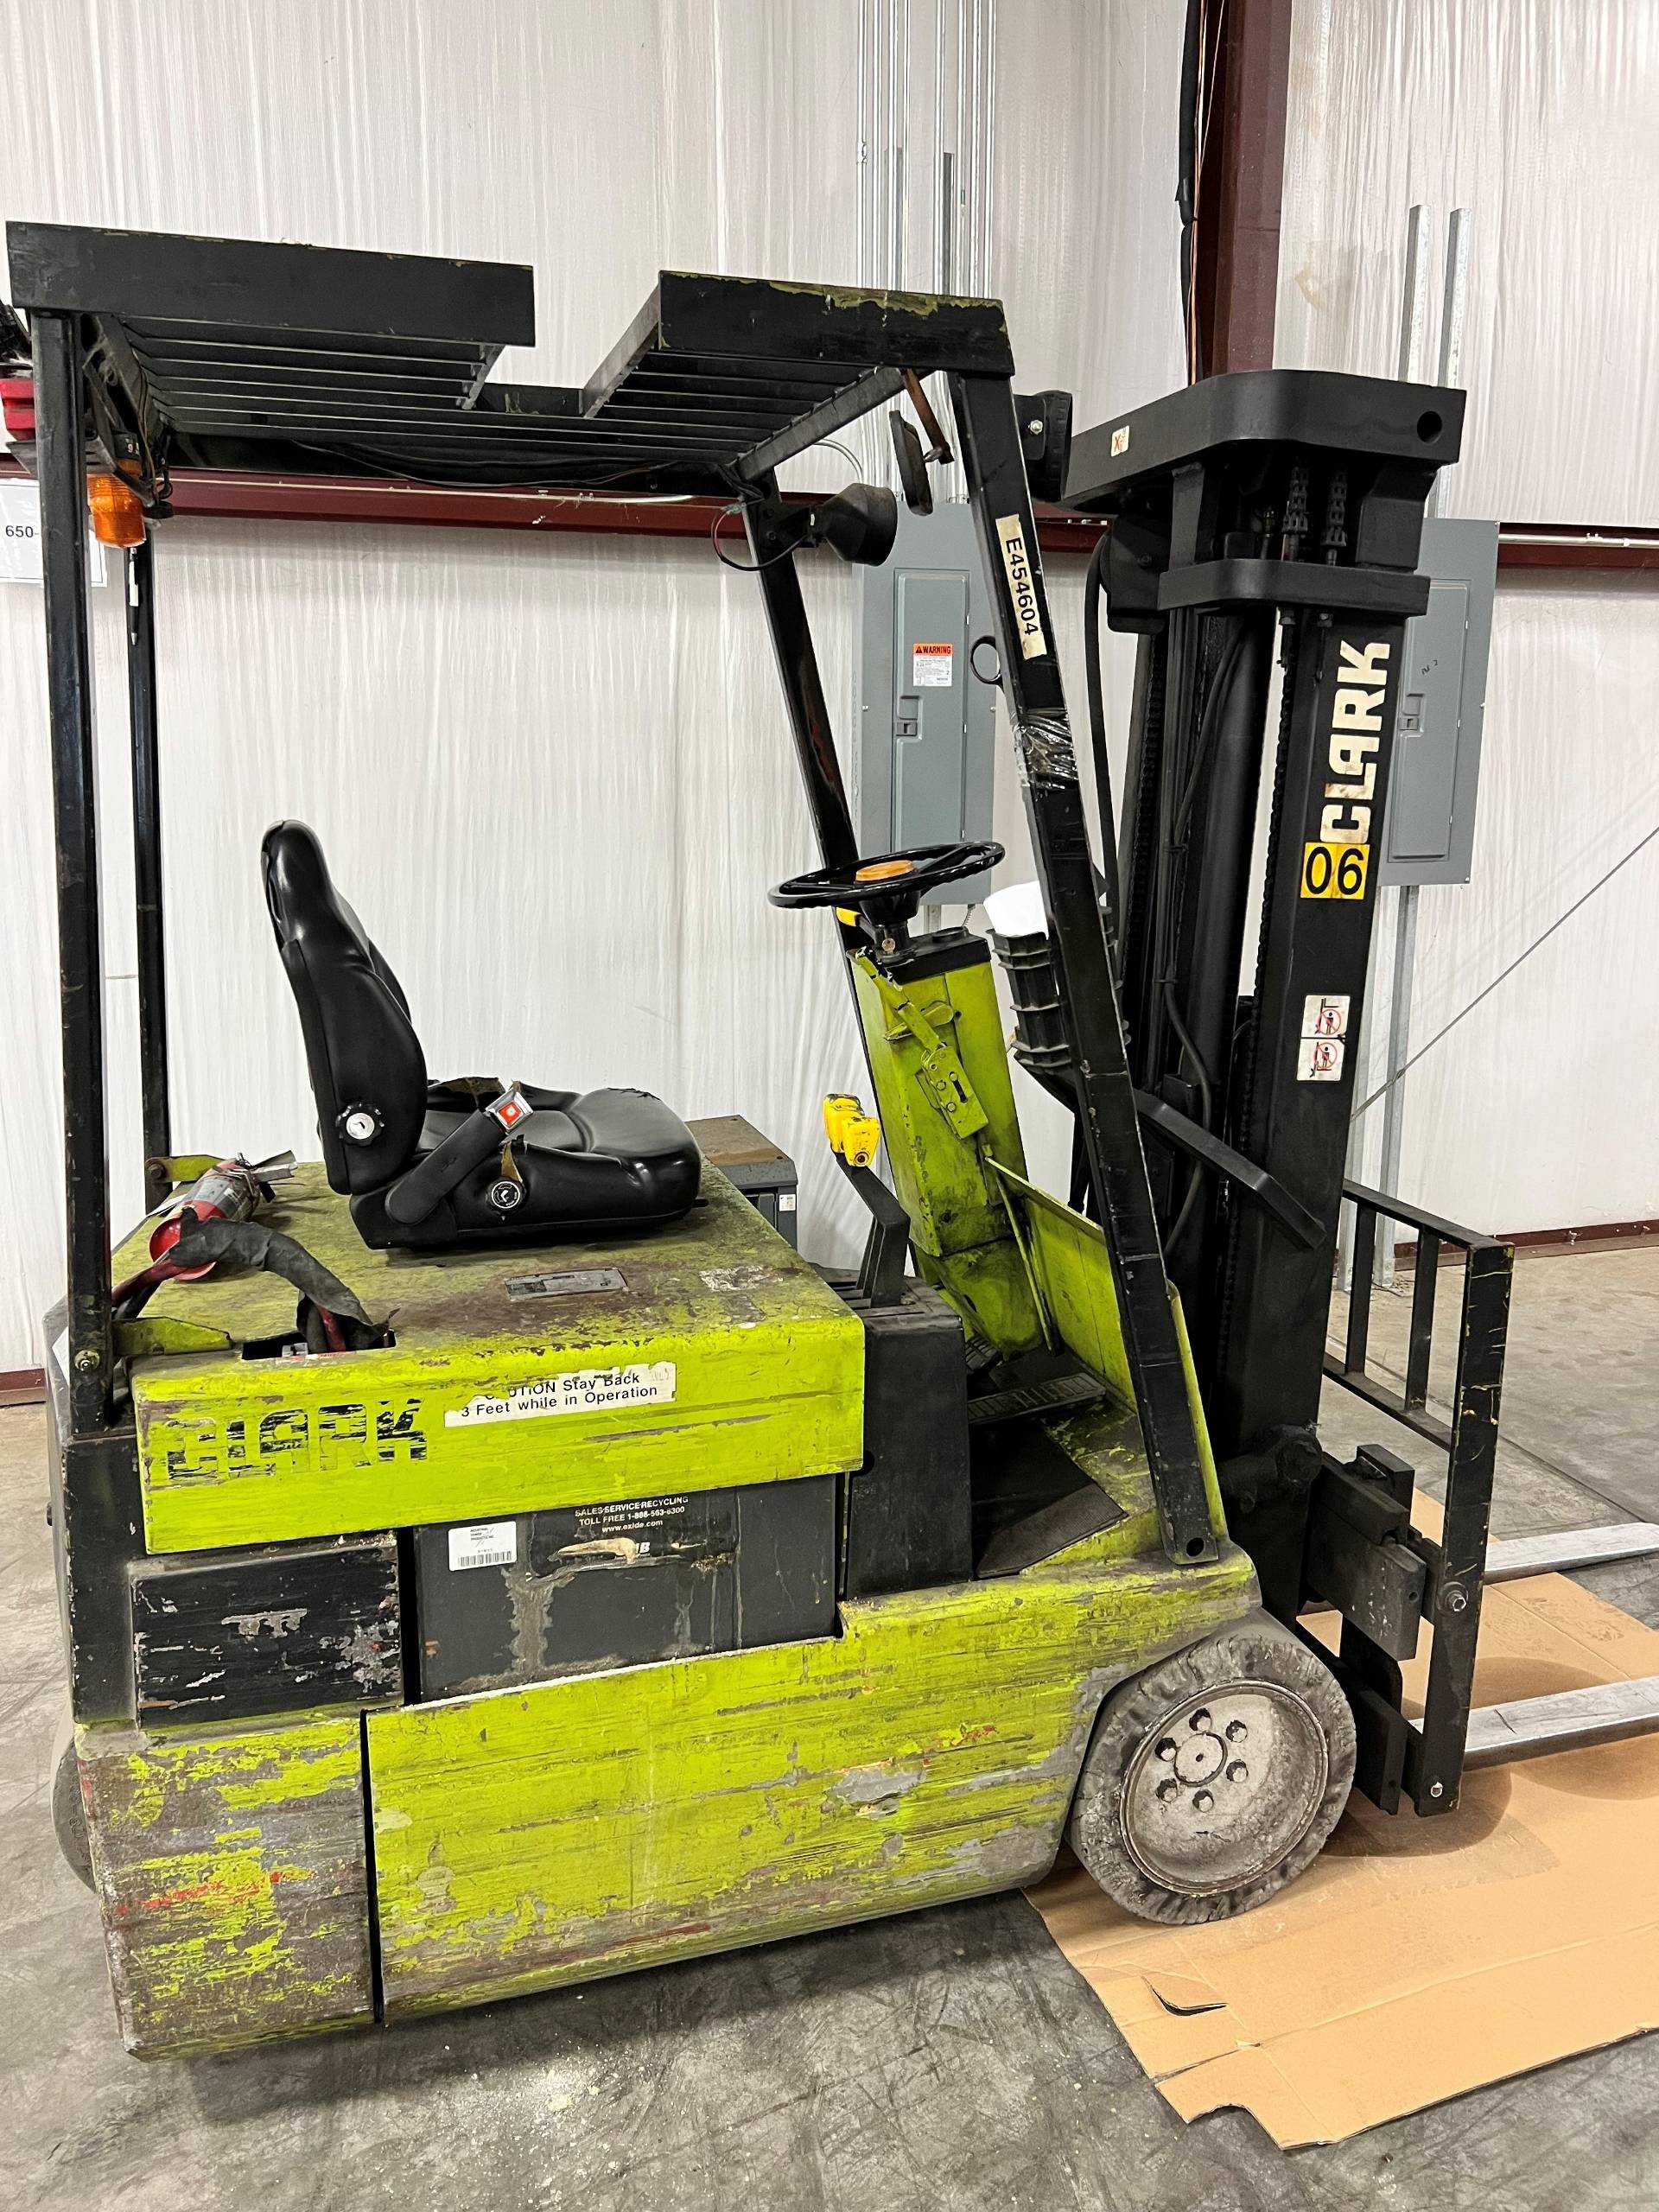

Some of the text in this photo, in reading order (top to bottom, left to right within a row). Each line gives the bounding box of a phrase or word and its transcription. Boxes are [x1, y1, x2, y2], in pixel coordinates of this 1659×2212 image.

[1006, 537, 1039, 636] E454604
[922, 645, 951, 654] WARNING
[1320, 640, 1391, 843] CLARK
[1305, 846, 1364, 896] 06
[486, 1381, 556, 1400] UTION
[563, 1379, 596, 1391] Stay
[604, 1372, 640, 1387] Back
[461, 1386, 658, 1417] 3 Feet while in Operation
[579, 1517, 601, 1527] TOLL
[602, 1514, 626, 1523] FREE
[601, 1519, 664, 1533] www.exide.com
